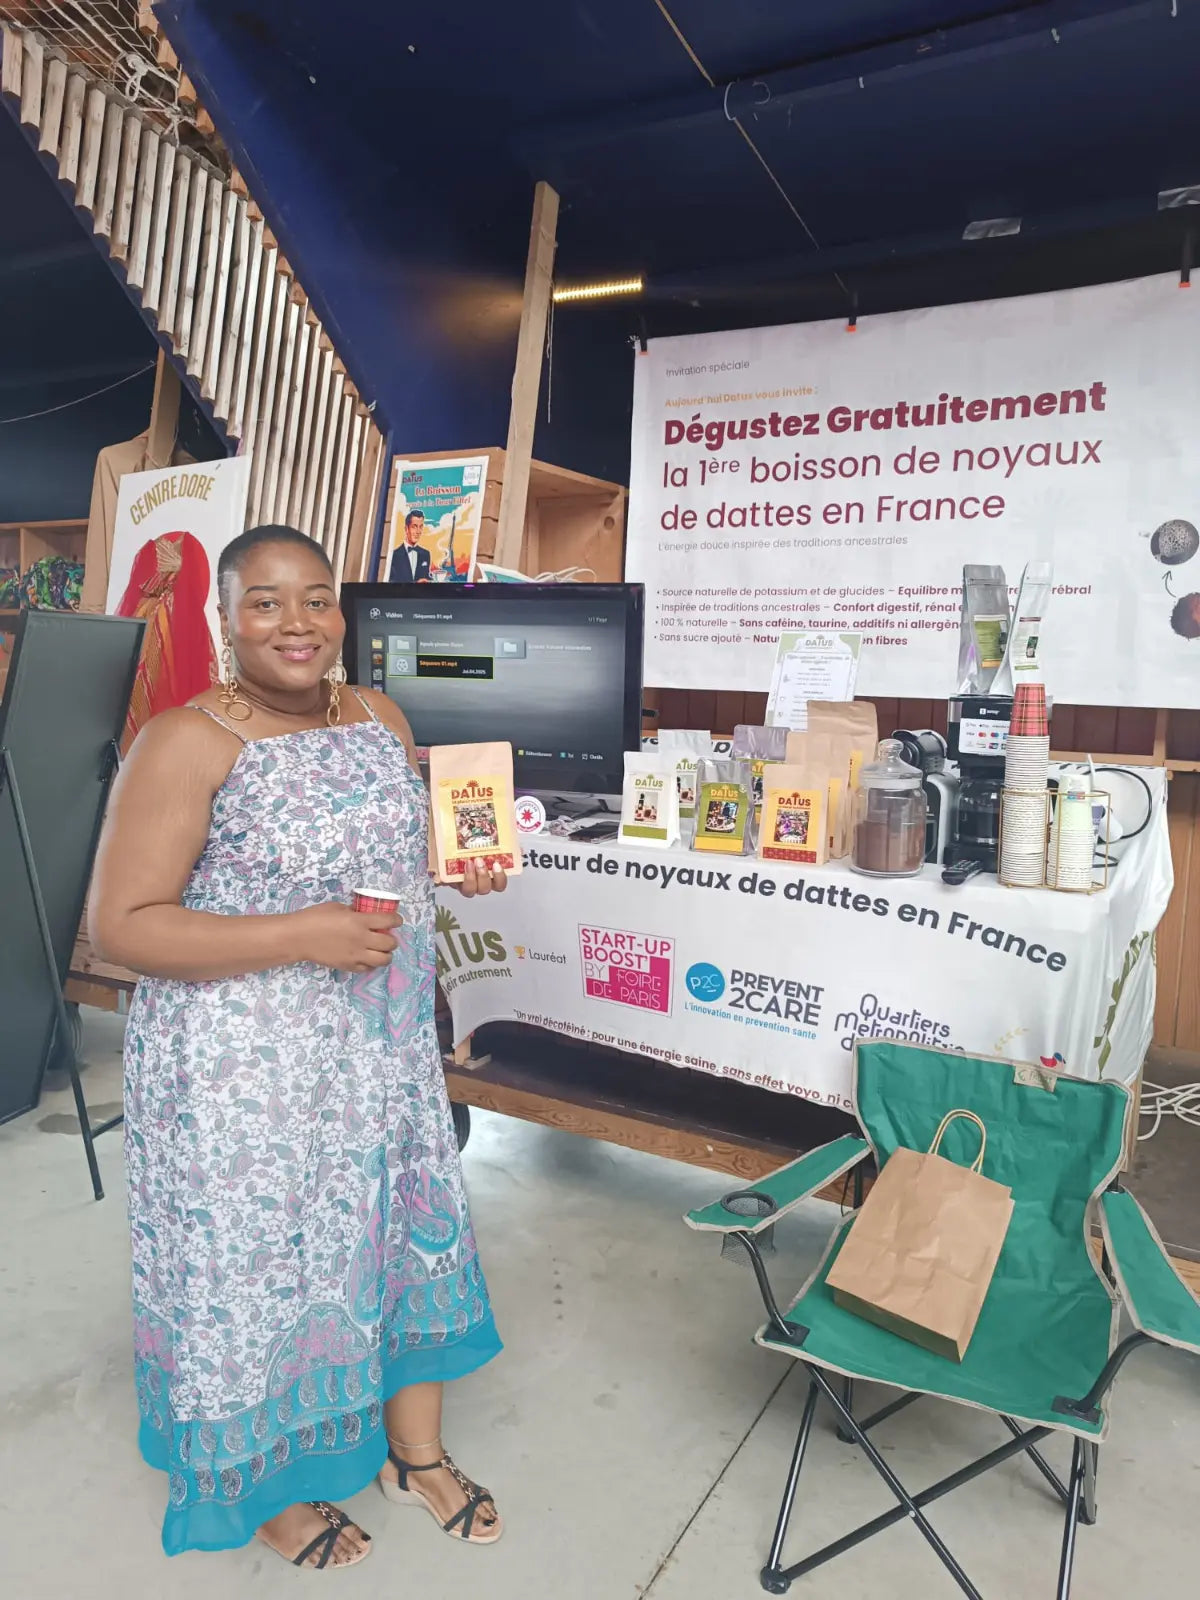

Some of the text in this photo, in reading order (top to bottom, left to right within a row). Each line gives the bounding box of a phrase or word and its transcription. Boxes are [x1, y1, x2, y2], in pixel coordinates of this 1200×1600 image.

[666, 360, 750, 377] Invitation spéciale
[755, 390, 780, 400] vous
[665, 382, 1106, 451] Dégustez Gratuitement
[663, 440, 1103, 488] la 1ère boisson de noyaux
[427, 484, 462, 496] Boisson
[130, 475, 178, 525] CEINTRE
[661, 495, 1005, 530] de dattes en France
[700, 540, 729, 550] douce
[731, 539, 770, 551] inspirée
[773, 538, 791, 549] des
[793, 537, 842, 548] traditions
[844, 535, 907, 547] ancestrales
[662, 588, 693, 597] Source
[695, 587, 737, 597] naturelle
[739, 587, 752, 597] de
[754, 587, 807, 598] potassium
[810, 588, 821, 596] et
[823, 587, 837, 596] de
[839, 586, 885, 598] glucides
[898, 586, 949, 597] Equilibre
[1051, 585, 1091, 595] rébral
[661, 603, 697, 613] Inspirée
[699, 602, 711, 612] de
[713, 602, 759, 612] traditions
[761, 603, 820, 612] ancestrales
[833, 602, 874, 613] Confort
[877, 602, 922, 614] digestif,
[925, 602, 956, 612] rénal
[660, 618, 675, 627] 100
[677, 618, 684, 627] %
[686, 618, 728, 628] naturelle
[739, 619, 763, 628] Sans
[808, 618, 850, 630] taurine,
[853, 618, 895, 629] additifs
[898, 618, 908, 628] ni
[659, 633, 680, 642] Sans
[683, 634, 708, 643] sucre
[875, 635, 907, 645] fibres
[805, 636, 833, 646] DATUS
[675, 759, 698, 770] ATUS
[635, 775, 663, 787] DATUS
[451, 781, 493, 800] DATUS
[711, 786, 739, 798] DATUS
[778, 793, 811, 806] DATUS
[586, 853, 619, 875] de
[625, 861, 732, 891] noyaux
[738, 872, 776, 896] de
[783, 879, 890, 916] dattes
[897, 903, 940, 929] en
[947, 911, 1067, 972] France
[581, 928, 672, 957] START-UP
[529, 948, 566, 964] Lauréat
[458, 967, 512, 984] autrement
[584, 962, 662, 992] BY FOIRE
[690, 974, 721, 990] P2C
[730, 969, 824, 1003] PREVENT
[592, 981, 661, 1010] DE PARIS
[684, 1001, 731, 1020] L'innovation
[733, 1013, 743, 1023] en
[728, 986, 822, 1026] 2CARE
[859, 993, 950, 1038] Quartiers
[528, 1013, 542, 1024] vrai
[592, 1030, 615, 1044] pour
[617, 1037, 637, 1050] une
[639, 1041, 682, 1062] énergie
[684, 1054, 719, 1073] saine,
[722, 1065, 752, 1081] sans
[754, 1074, 784, 1090] effet
[827, 1092, 840, 1105] ni
